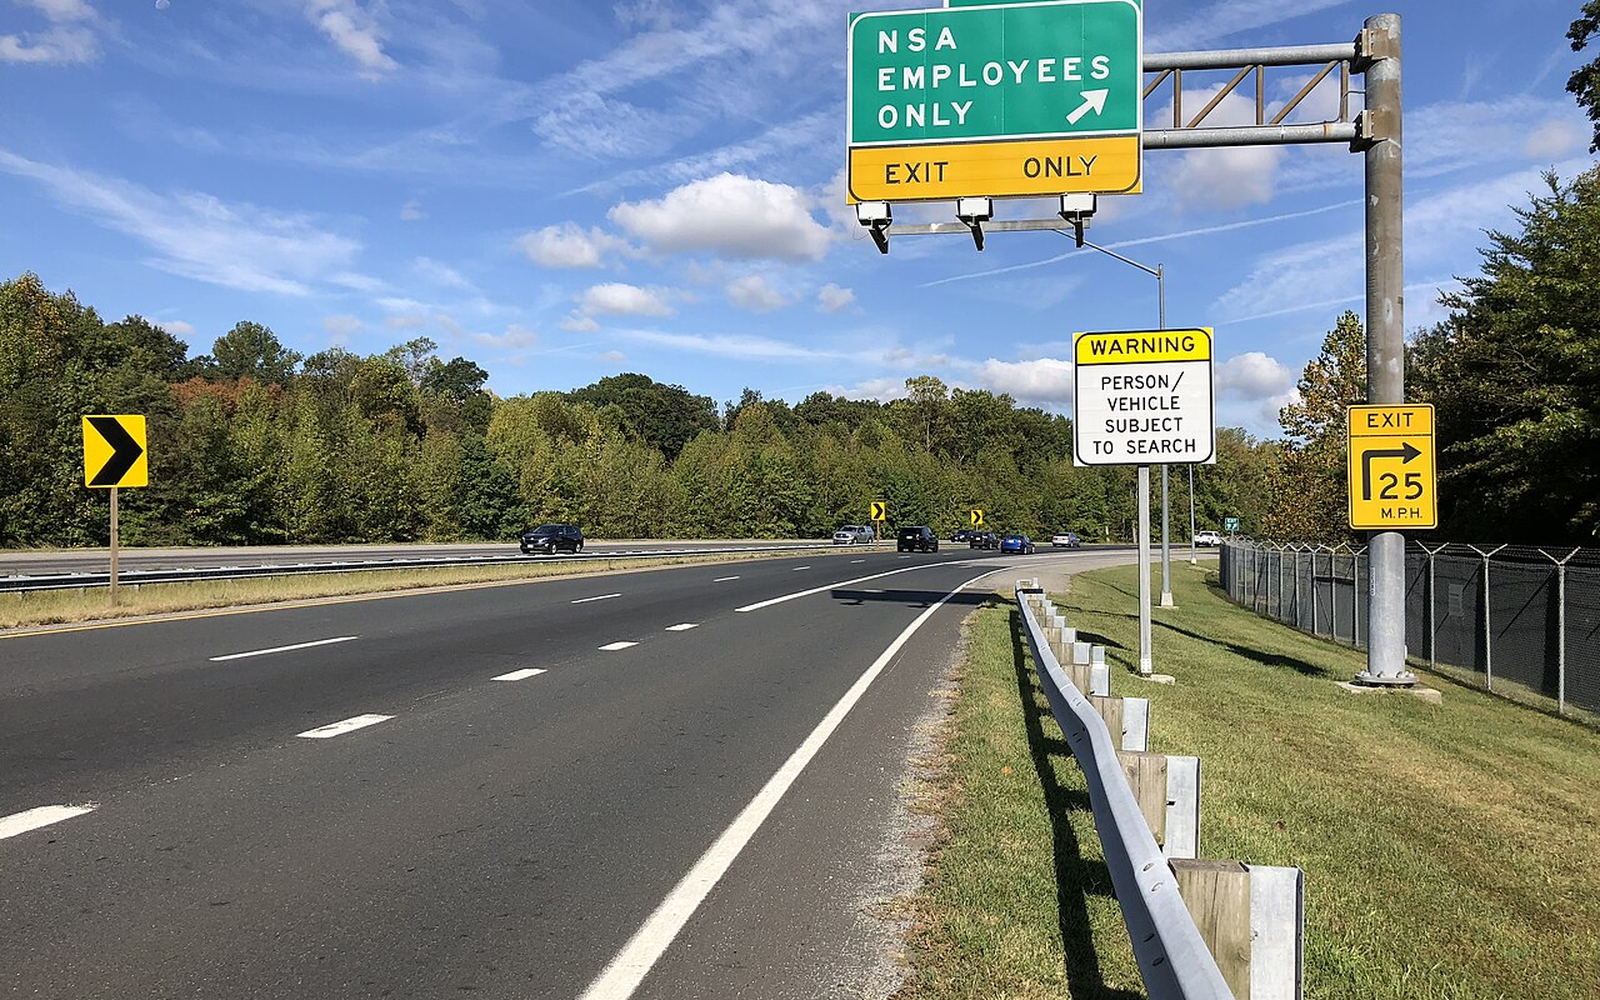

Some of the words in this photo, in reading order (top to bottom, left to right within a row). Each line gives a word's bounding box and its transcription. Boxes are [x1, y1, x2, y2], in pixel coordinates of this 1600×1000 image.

[878, 27, 957, 53] NSA
[878, 55, 1110, 91] EMPLOYEES
[878, 101, 973, 129] ONLY
[885, 161, 949, 184] EXIT
[1023, 155, 1098, 178] ONLY
[1091, 336, 1195, 355] WARNING
[1101, 371, 1184, 392] PERSON/
[1107, 396, 1180, 411] VEHICLE
[1105, 417, 1183, 433] SUBJECT
[1367, 412, 1414, 428] EXIT
[1093, 440, 1114, 455] TO
[1126, 438, 1196, 455] SEARCH
[1379, 472, 1424, 500] 25
[1381, 507, 1424, 519] M.P.H.
